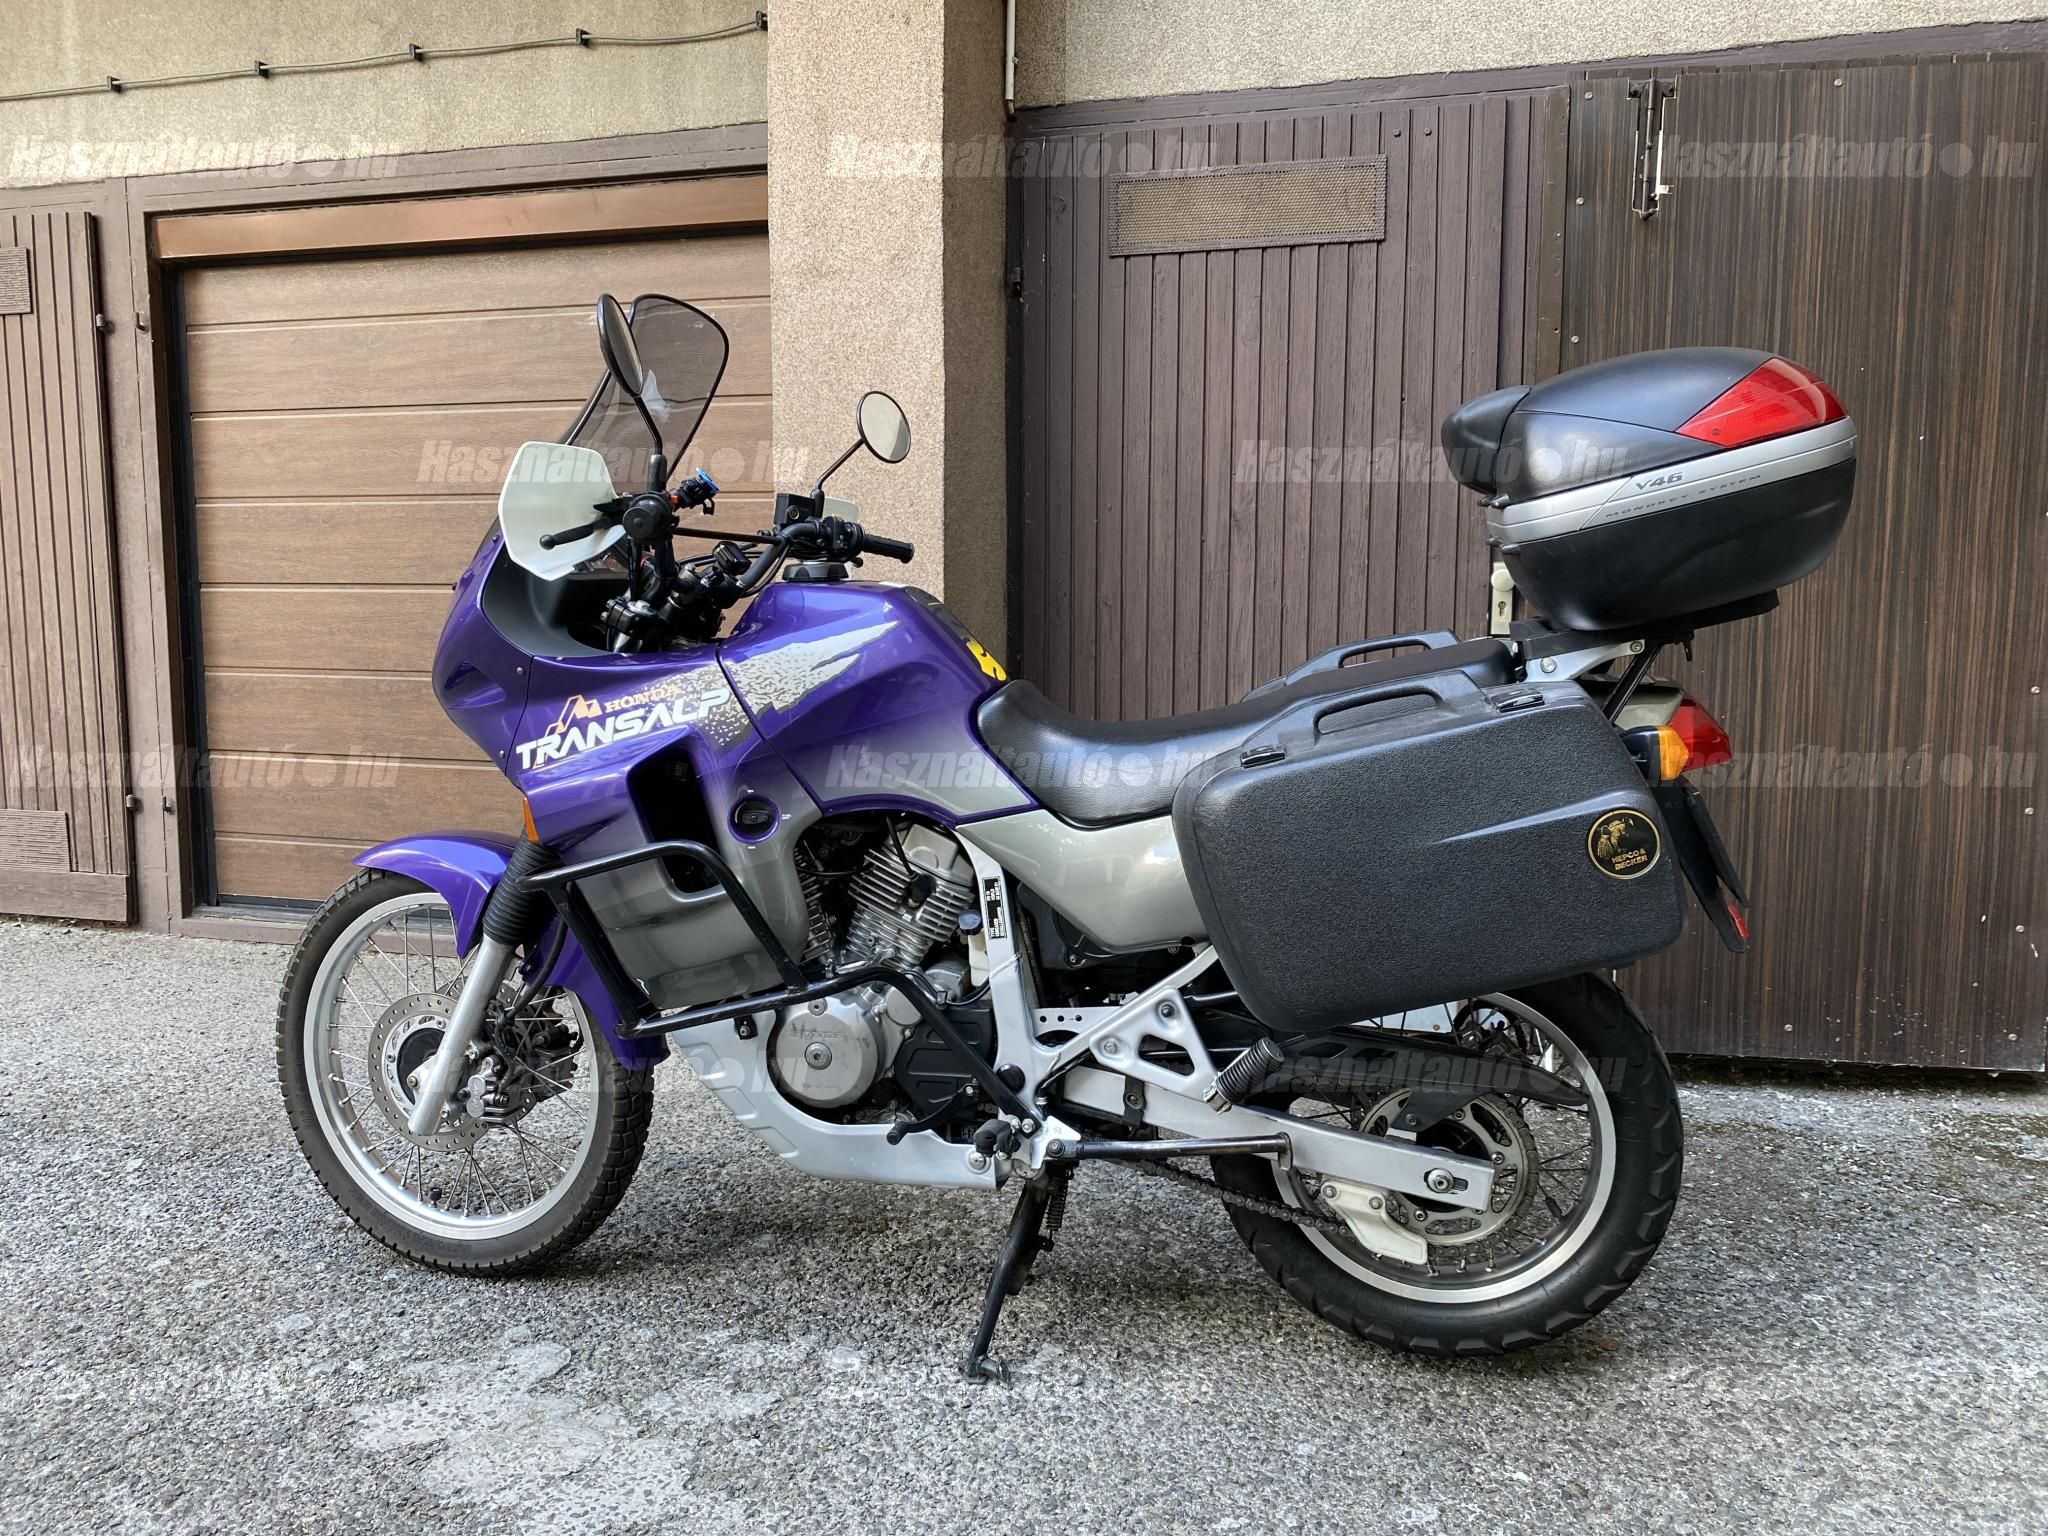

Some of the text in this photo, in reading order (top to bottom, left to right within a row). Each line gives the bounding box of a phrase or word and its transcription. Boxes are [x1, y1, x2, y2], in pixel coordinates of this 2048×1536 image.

[1635, 472, 1684, 491] V46
[604, 684, 684, 713] HONDA
[516, 687, 731, 770] TRANSALP
